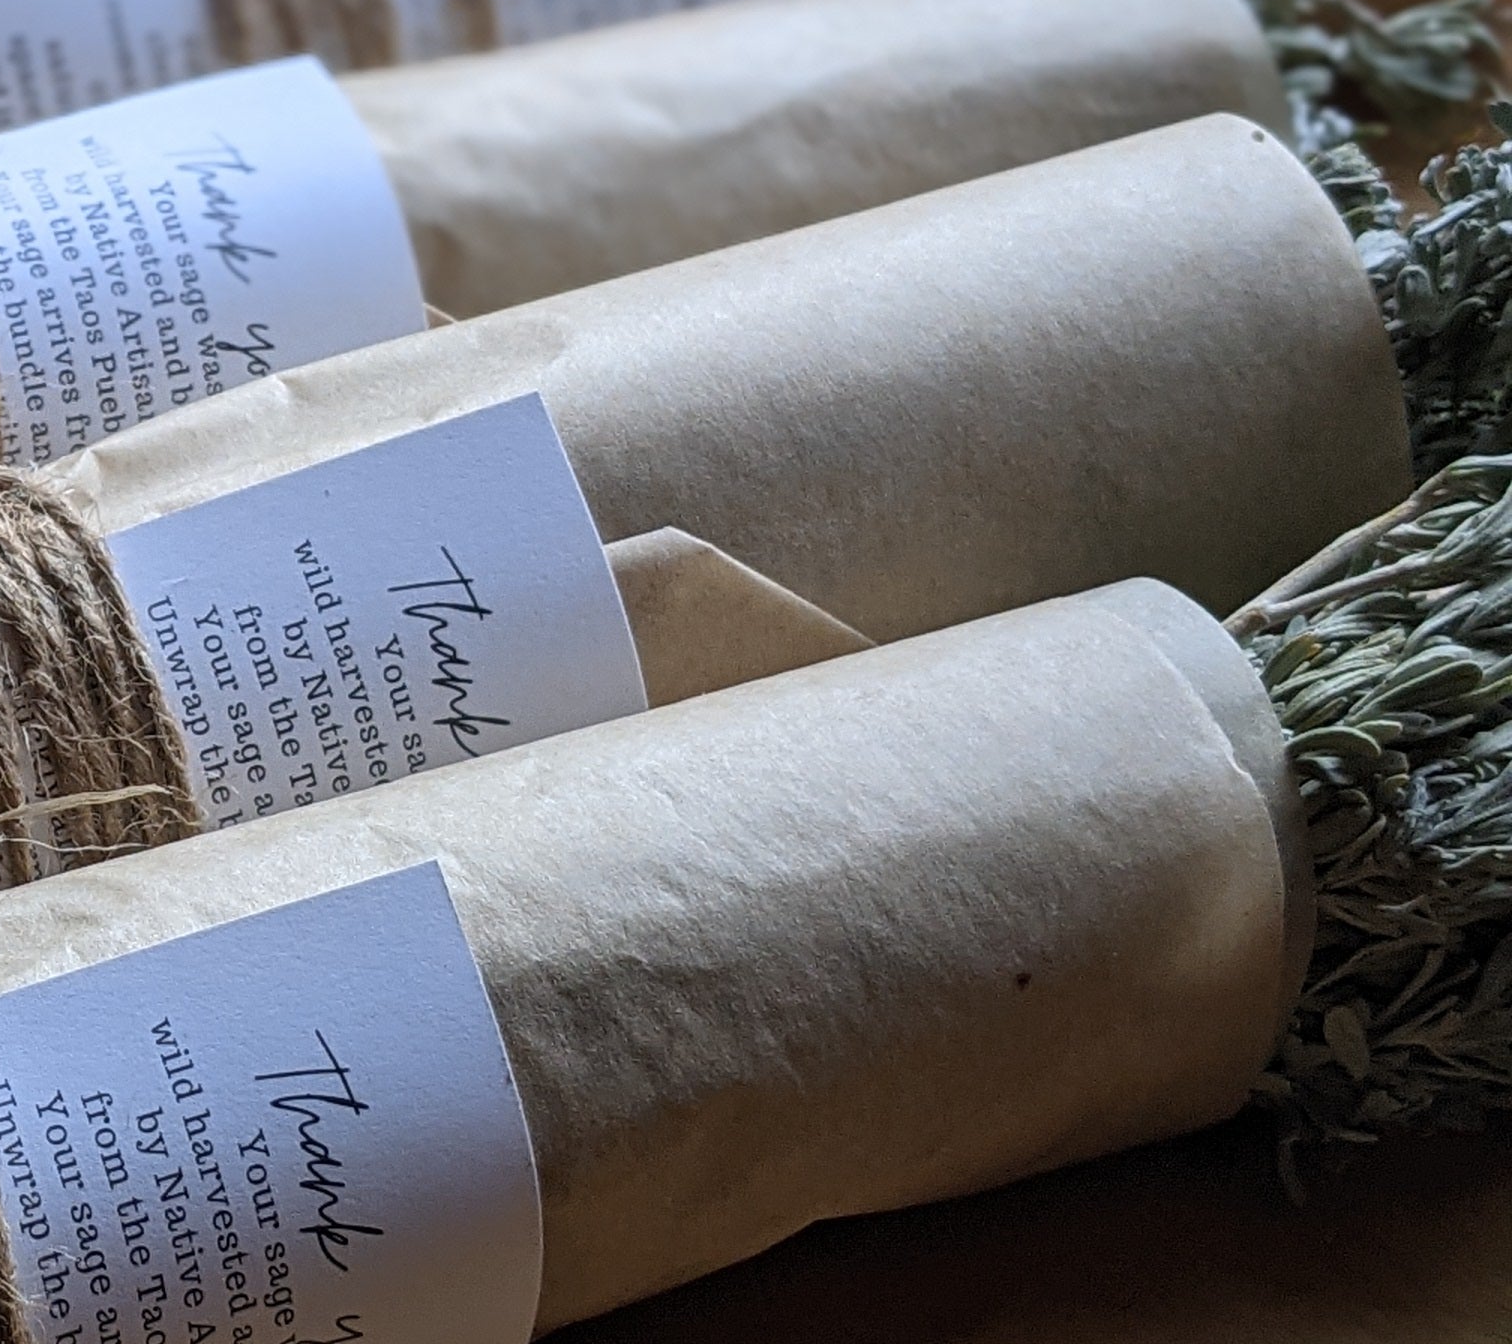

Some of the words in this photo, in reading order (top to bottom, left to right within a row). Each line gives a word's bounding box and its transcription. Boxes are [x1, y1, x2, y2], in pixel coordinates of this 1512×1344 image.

[82, 202, 128, 296] Native
[104, 173, 173, 306] harvested
[157, 317, 190, 379] and
[149, 181, 187, 244] Your
[177, 253, 209, 325] sage
[198, 333, 223, 395] was
[162, 132, 276, 284] Thank
[5, 300, 44, 411] bundle
[12, 218, 48, 278] sage
[37, 286, 79, 404] arrives
[50, 216, 79, 262] the
[70, 268, 103, 344] Taos
[91, 355, 127, 433] Pueb
[217, 324, 275, 376] yo
[294, 539, 342, 612] wild
[388, 546, 510, 758] Thank
[147, 595, 210, 736] Unwrap
[199, 743, 231, 804] the
[193, 604, 239, 692] Your
[228, 701, 266, 783] sage
[232, 604, 279, 690] from
[269, 696, 301, 756] the
[283, 618, 314, 661] by
[301, 670, 351, 793] Native
[375, 633, 415, 722] Your
[403, 732, 428, 773] sa
[35, 1089, 84, 1191] Your
[70, 1202, 111, 1297] sage
[81, 1091, 129, 1189] from
[116, 1196, 152, 1266] the
[136, 1106, 170, 1159] by
[154, 1166, 205, 1309] Native
[151, 1016, 204, 1104] wild
[184, 1106, 258, 1328] harvested
[238, 1128, 281, 1230] Your
[264, 1242, 296, 1341] sage
[255, 1029, 384, 1272] Thank
[37, 1249, 71, 1320] the
